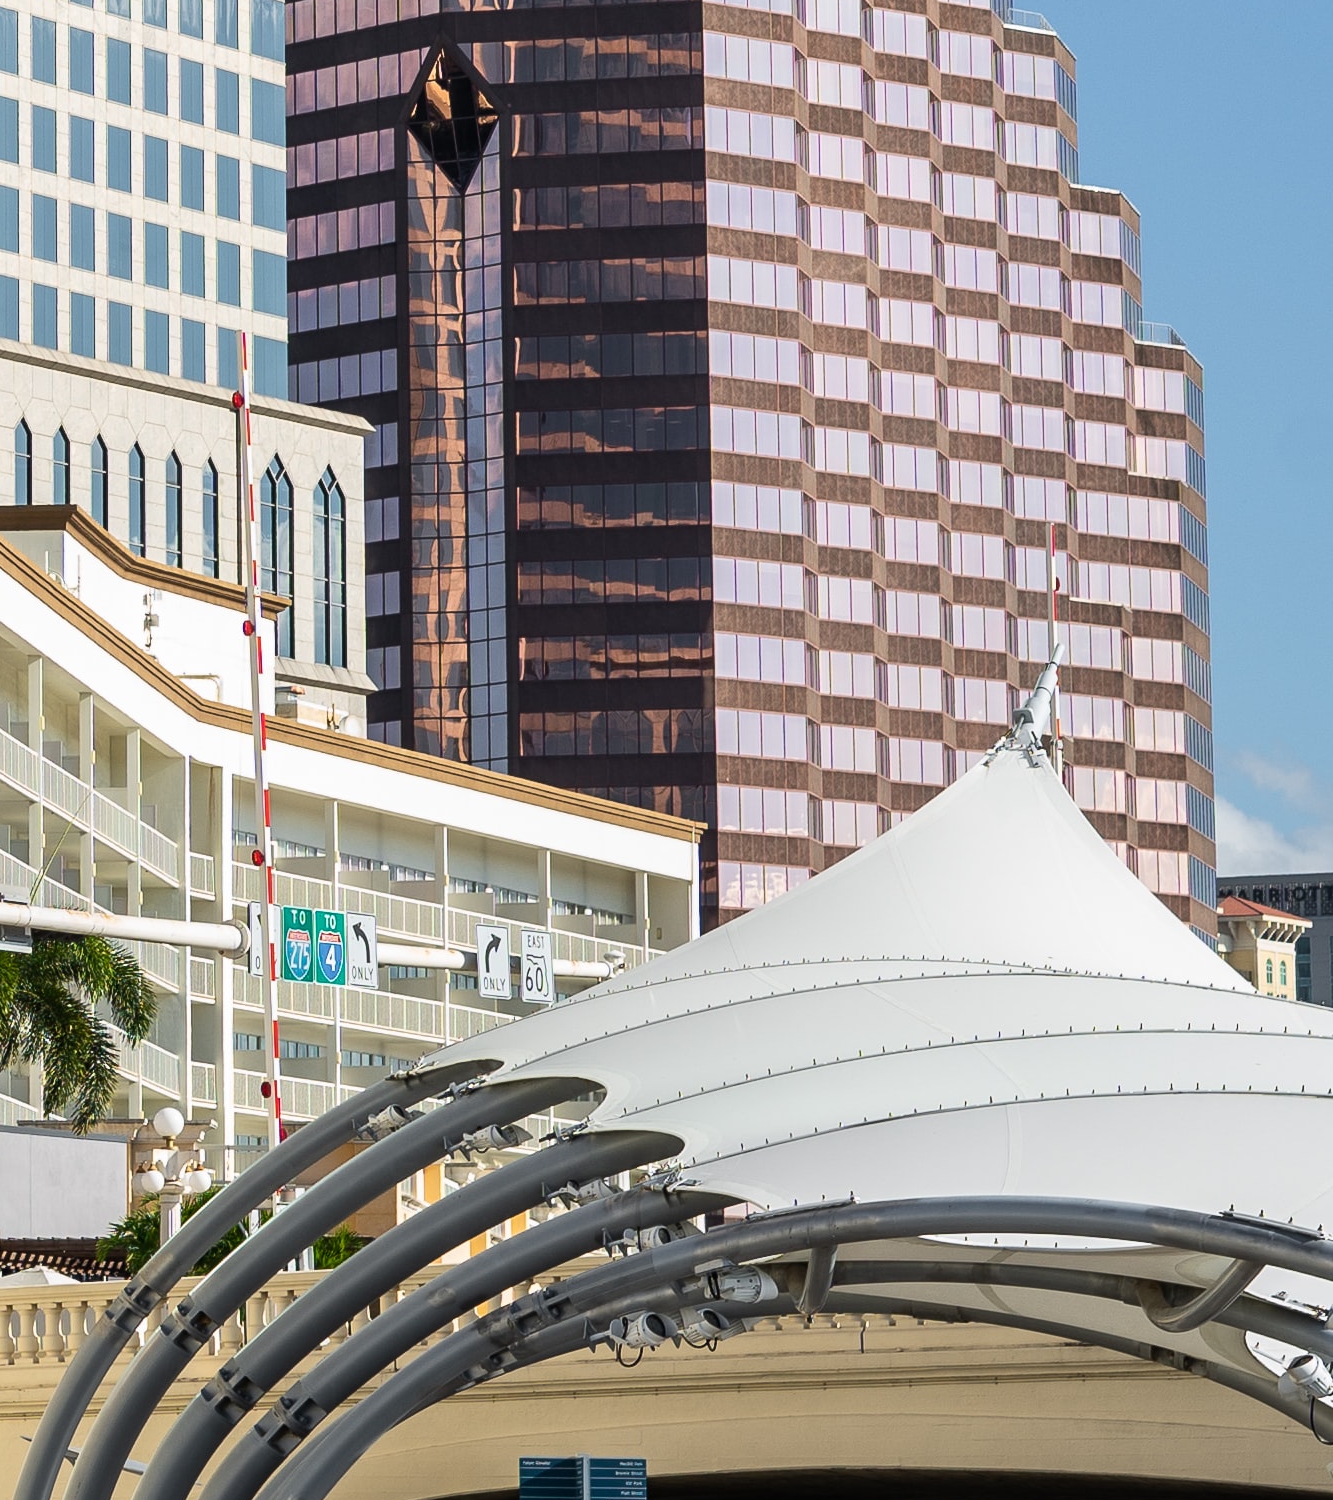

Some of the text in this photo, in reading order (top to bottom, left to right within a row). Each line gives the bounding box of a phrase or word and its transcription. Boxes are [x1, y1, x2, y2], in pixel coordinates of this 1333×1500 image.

[291, 910, 306, 925] TO
[324, 914, 337, 929] TO
[527, 934, 545, 949] EAST
[290, 941, 310, 970] 275
[325, 945, 337, 972] 4
[351, 965, 374, 981] ONLY
[525, 967, 544, 992] 60
[483, 976, 506, 991] ONLY
